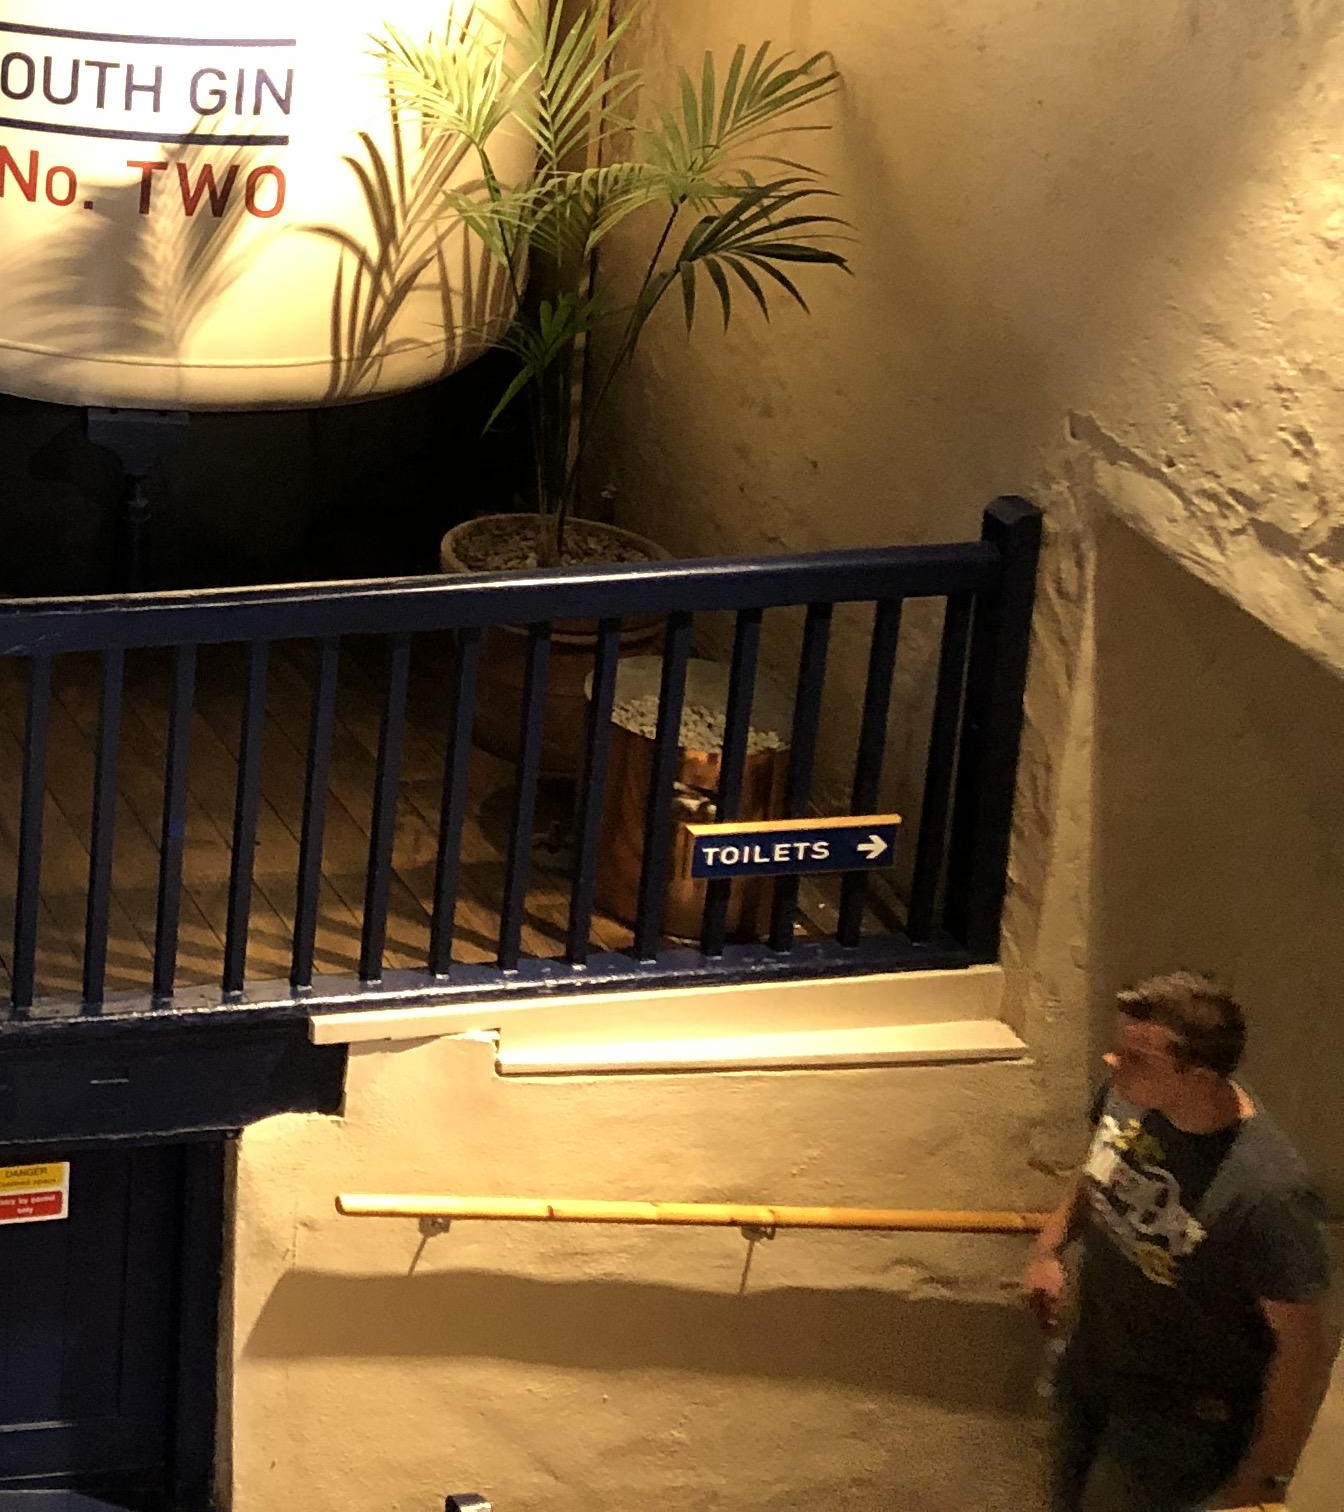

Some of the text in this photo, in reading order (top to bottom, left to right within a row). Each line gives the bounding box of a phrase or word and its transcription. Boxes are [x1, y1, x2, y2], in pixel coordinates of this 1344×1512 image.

[189, 66, 296, 117] GIN
[126, 159, 288, 220] TWO
[701, 841, 831, 867] TOILETS
[5, 1167, 48, 1178] DANGER
